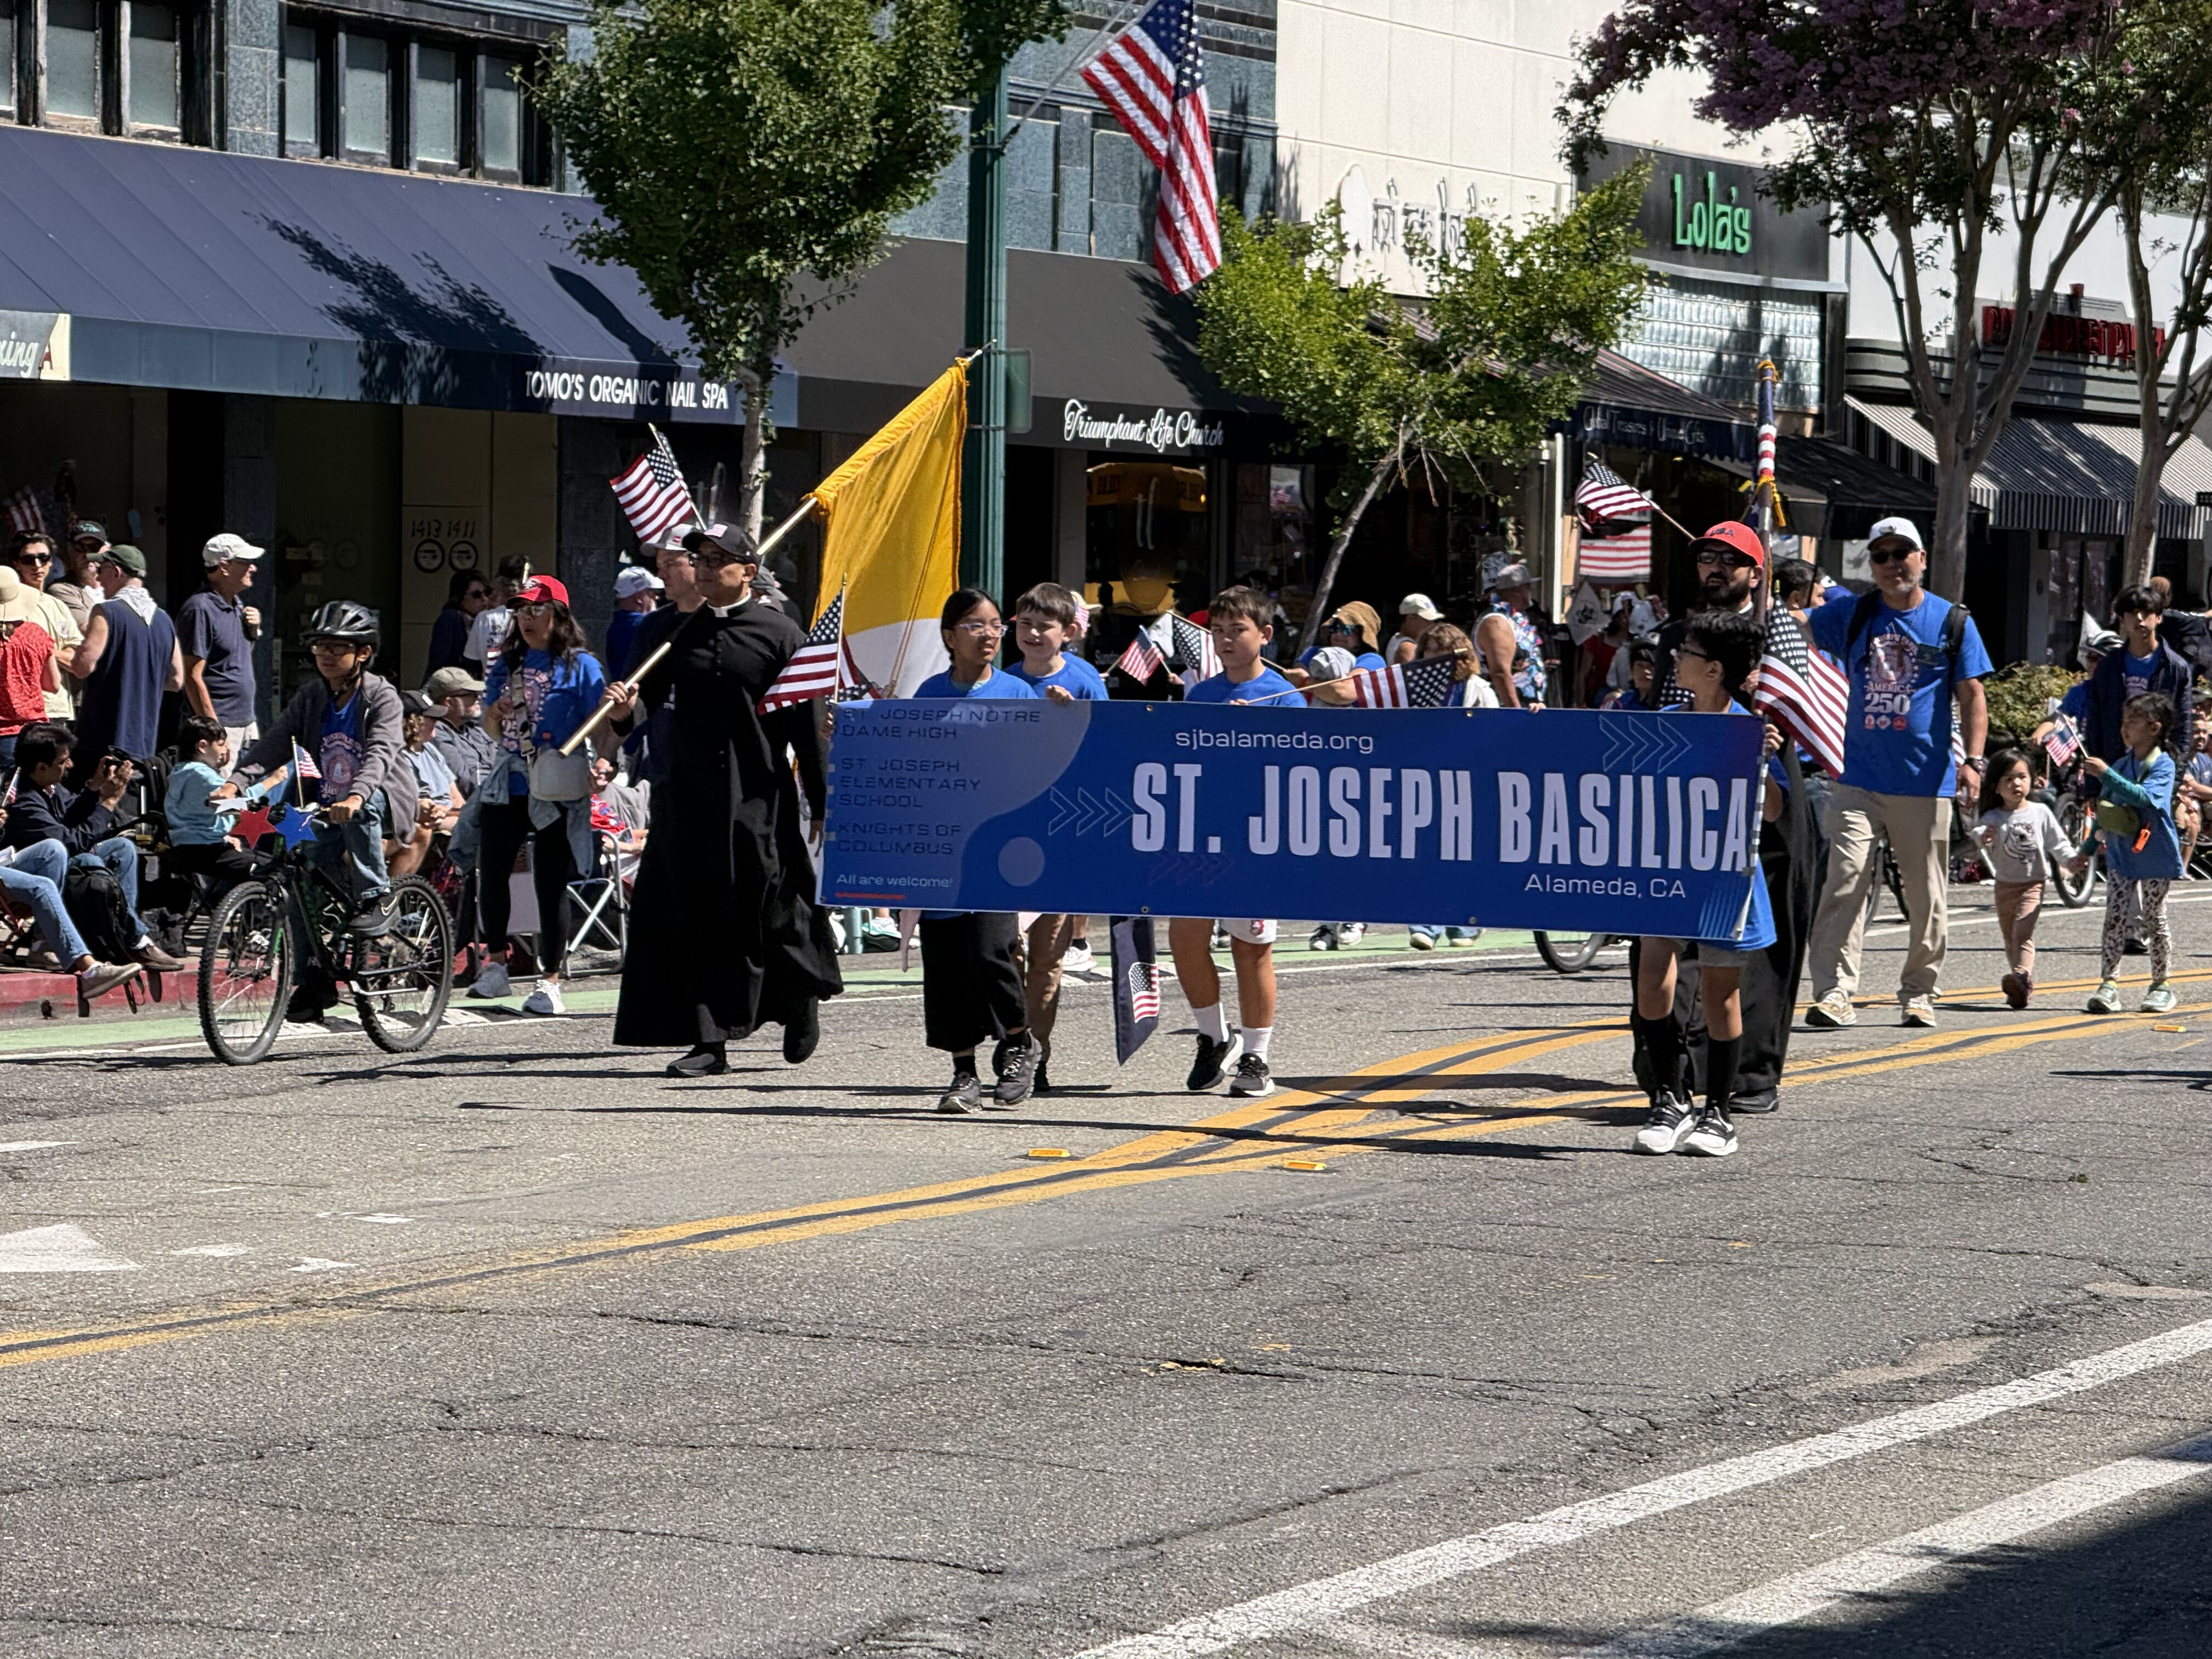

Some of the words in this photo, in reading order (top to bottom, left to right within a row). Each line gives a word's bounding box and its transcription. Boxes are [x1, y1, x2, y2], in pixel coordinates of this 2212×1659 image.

[1674, 171, 1752, 254] Lola's
[526, 371, 585, 401] TOMO'S
[590, 375, 661, 405] ORGANIC
[665, 381, 698, 408] NAIL
[702, 383, 729, 409] SPA
[1064, 399, 1147, 449] Triumphant
[1146, 408, 1174, 453] Life
[1175, 411, 1224, 448] Church
[411, 519, 442, 538] 1413
[447, 520, 476, 538] 1411
[1864, 680, 1916, 694] AMERICA
[1864, 692, 1911, 715] 250
[881, 708, 962, 721] JOSEPH
[969, 710, 1041, 723] NOTRE
[842, 725, 902, 738] DAME
[909, 726, 957, 739] HIGH
[1175, 729, 1374, 754] sjbalameda.org
[878, 759, 960, 772] JOSEPH
[840, 776, 981, 791] ELEMENTARY
[838, 793, 923, 808] SCHOOL
[1132, 762, 1221, 854] ST.
[1248, 765, 1472, 861] JOSEPH
[1498, 771, 1749, 872] BASILICA
[837, 822, 929, 836] KNIGHTS
[936, 824, 962, 837] OF
[837, 839, 953, 855] COLUMBUS
[836, 874, 856, 885] All
[859, 876, 884, 885] are
[887, 876, 953, 888] welcome!
[1525, 873, 1641, 899] Alameda,
[1650, 878, 1686, 899] CA
